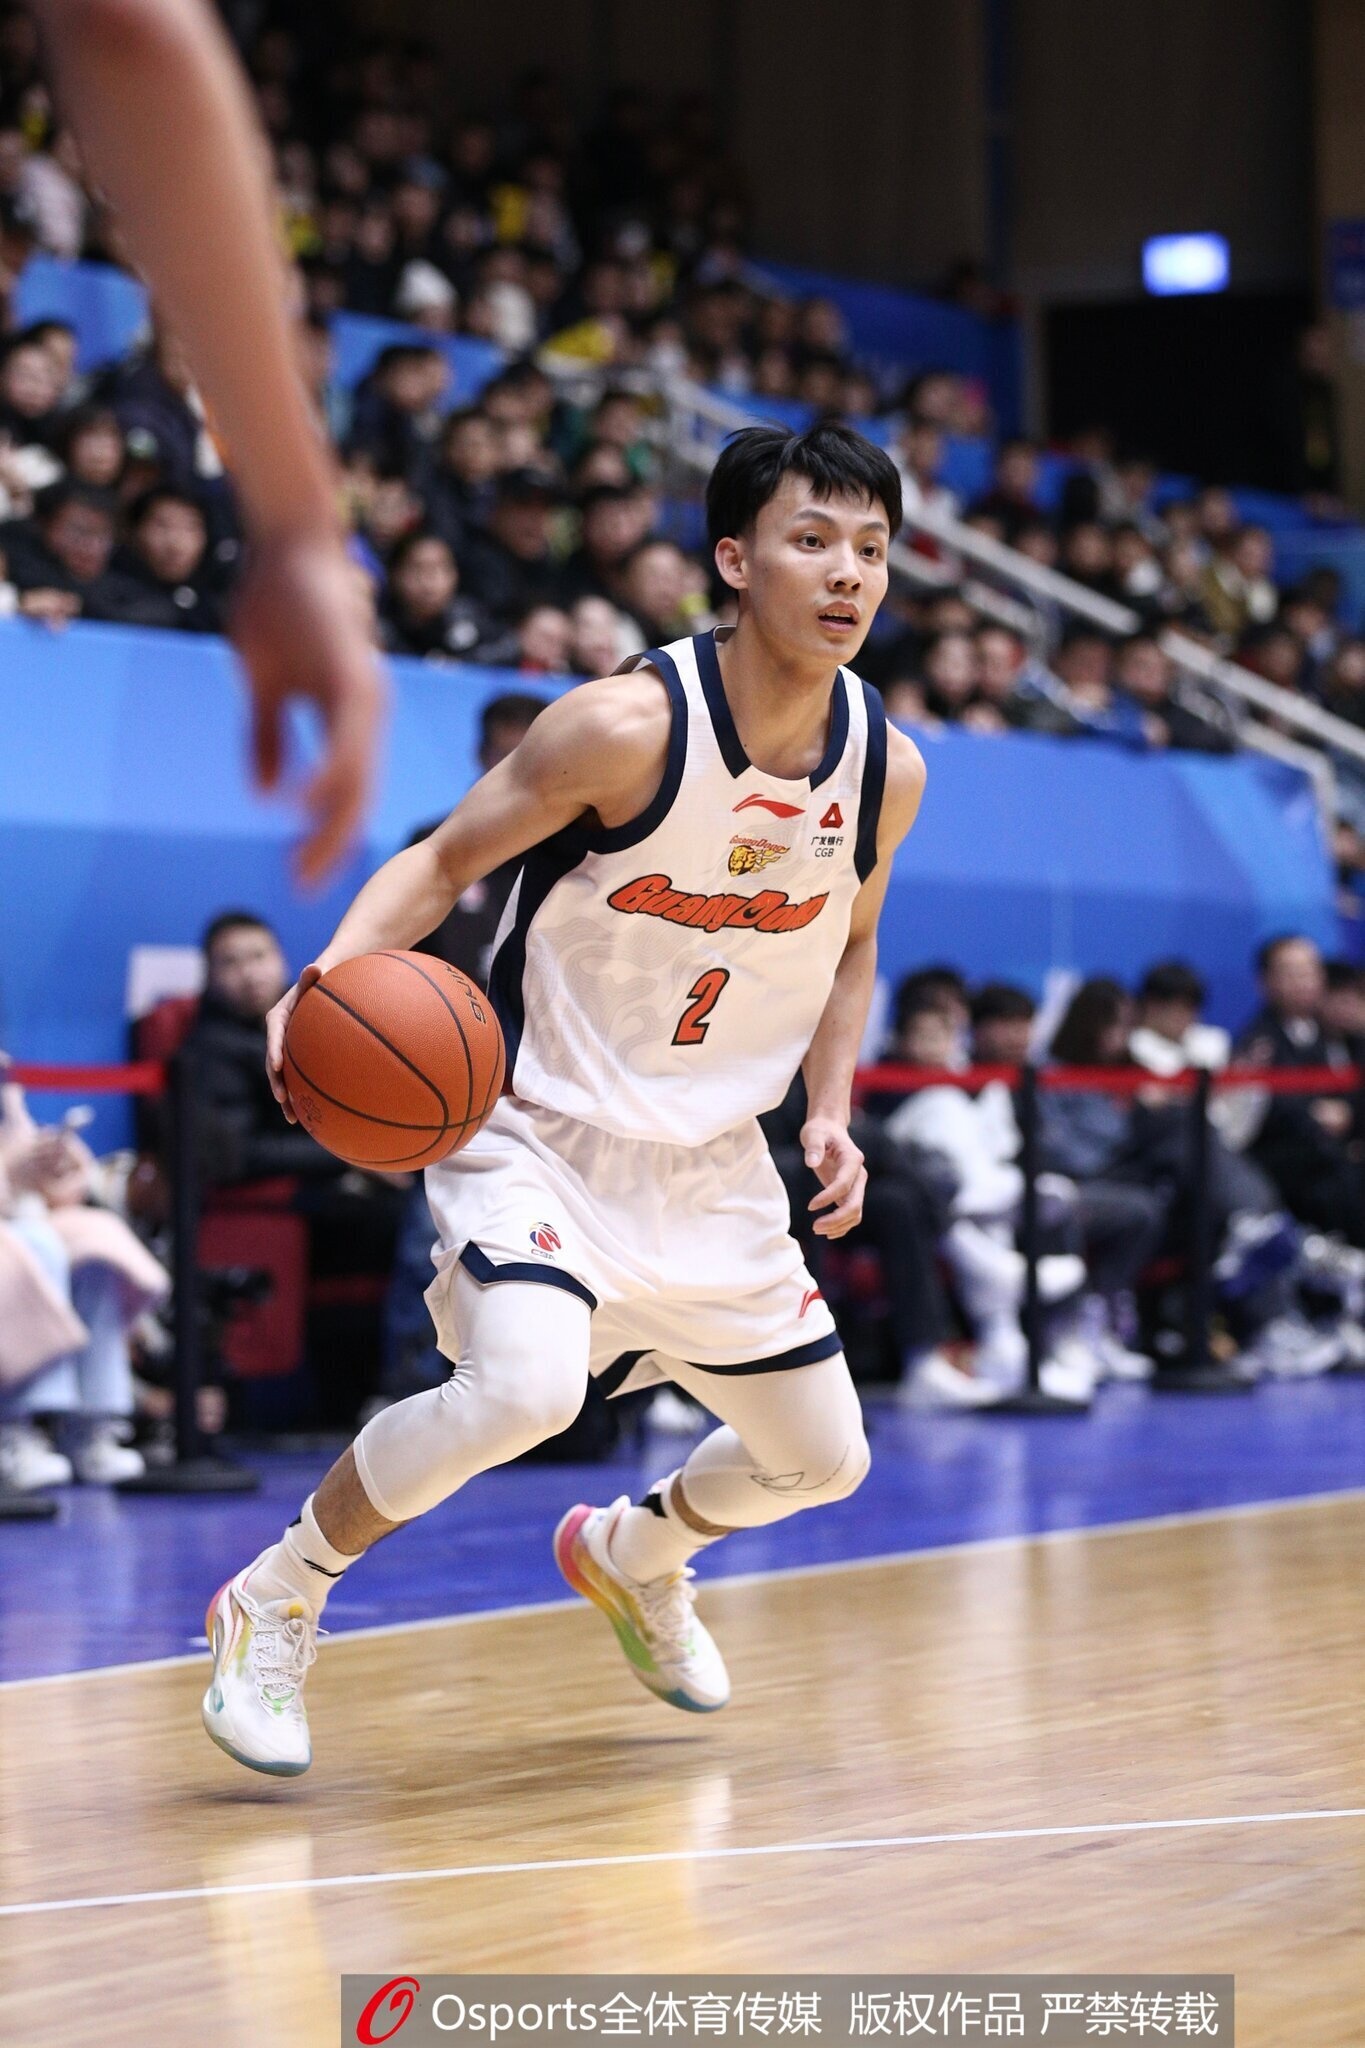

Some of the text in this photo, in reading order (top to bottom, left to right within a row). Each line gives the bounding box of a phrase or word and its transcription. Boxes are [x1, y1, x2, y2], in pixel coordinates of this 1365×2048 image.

[810, 836, 844, 846] 广发银行
[814, 847, 835, 858] CGB
[671, 967, 730, 1046] 2
